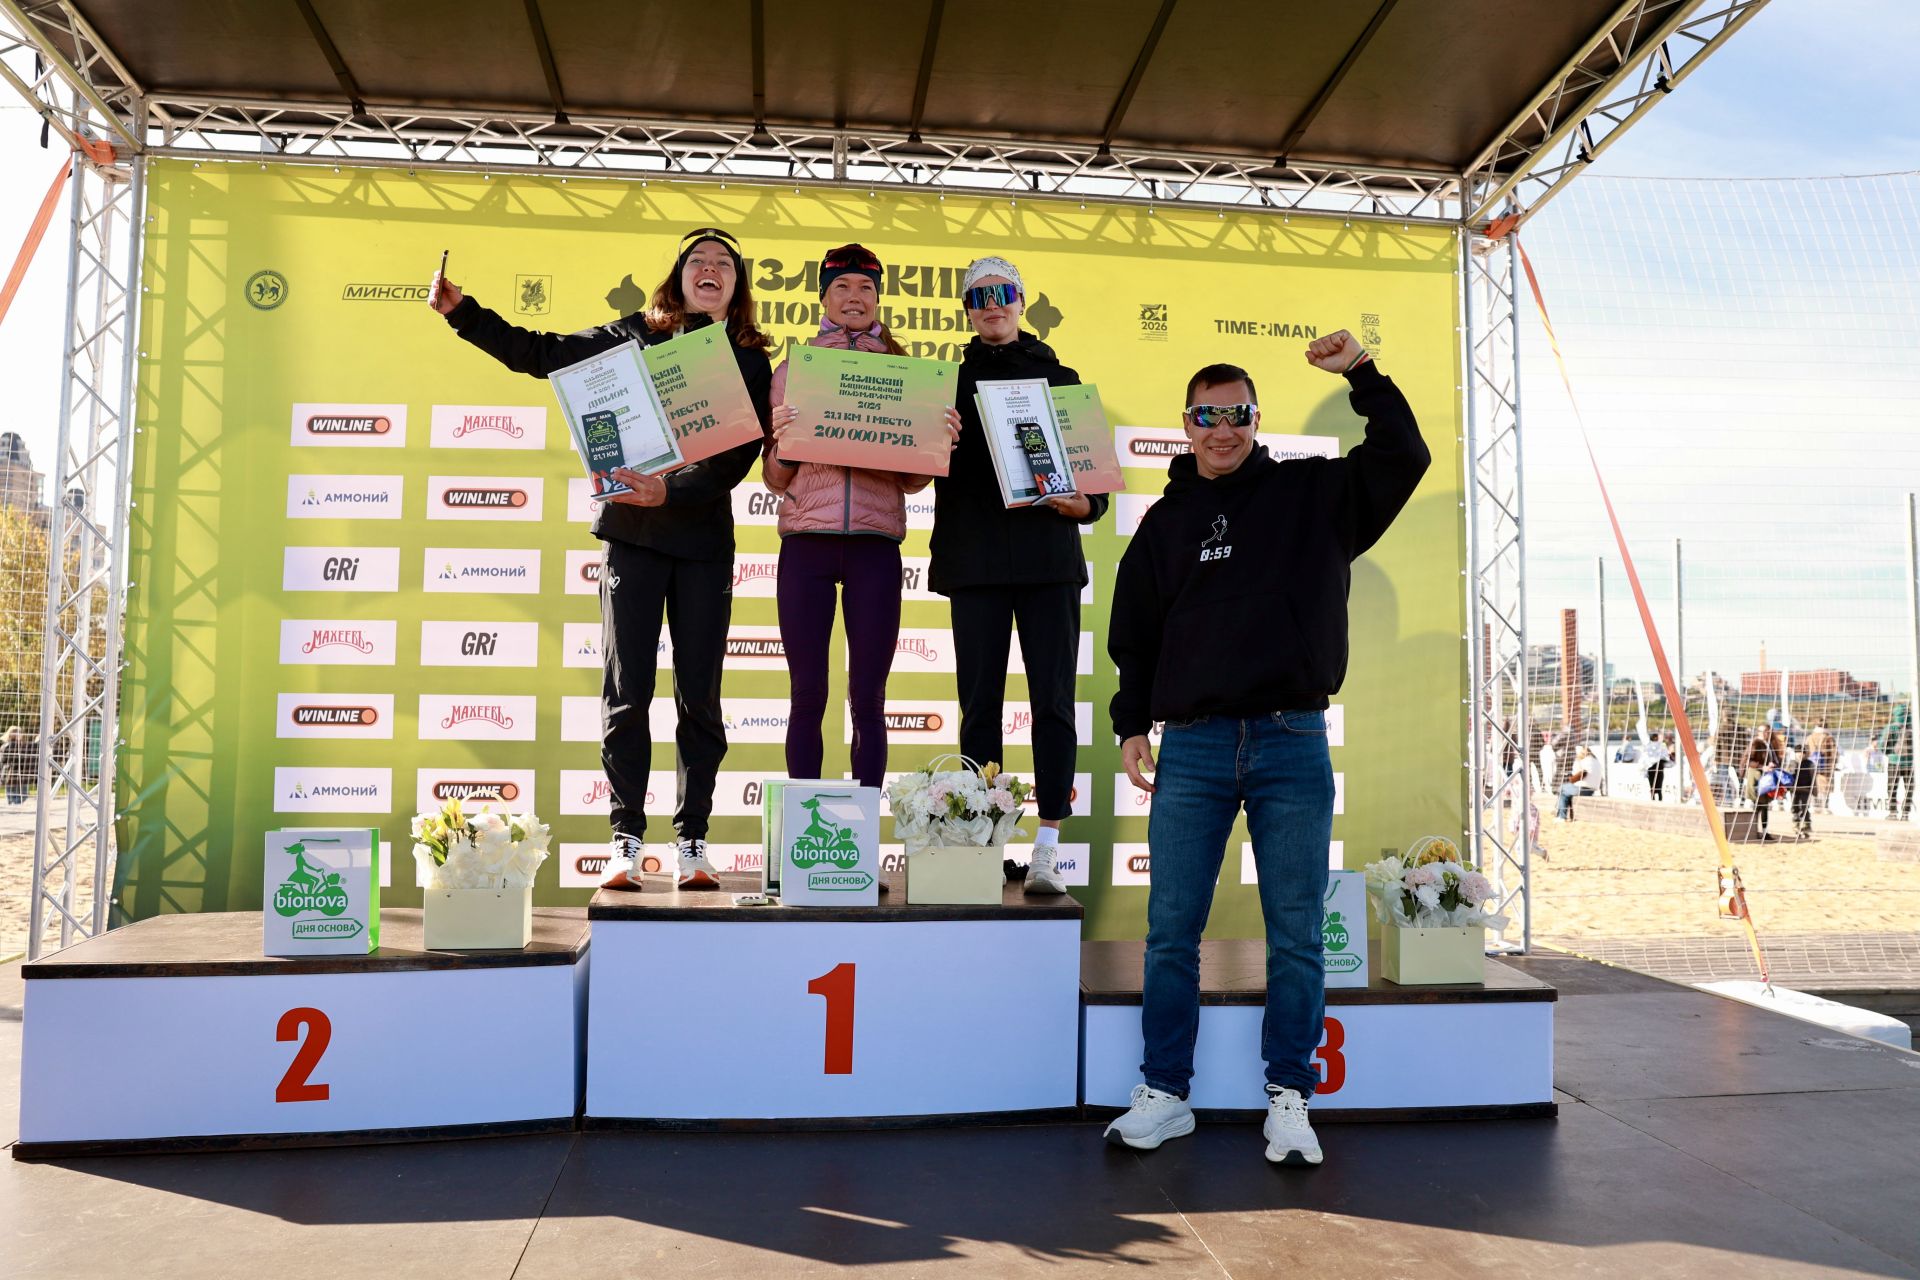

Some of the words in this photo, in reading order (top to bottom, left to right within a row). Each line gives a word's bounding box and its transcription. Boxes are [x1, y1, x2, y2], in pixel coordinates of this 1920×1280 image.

[346, 286, 431, 299] МИНСПО
[1141, 321, 1168, 331] 2026
[841, 373, 904, 387] КАЗАНСКИЙ
[588, 387, 629, 412] ДИПЛОМ
[857, 401, 881, 410] 2026
[670, 400, 709, 420] МЕСТО
[313, 419, 373, 432] WINLINE
[681, 414, 720, 438] РУБ.
[824, 411, 841, 420] 21,1
[844, 412, 861, 422] КМ
[872, 415, 911, 427] МЕСТО
[814, 425, 845, 439] 200
[848, 429, 877, 443] 000
[879, 431, 917, 447] РУБ.
[1134, 441, 1189, 455] WINLINE
[324, 491, 388, 503] АММОНИЙ
[449, 492, 510, 505] WINLINE
[1200, 545, 1232, 561] 0:59
[323, 557, 359, 581] GRi
[461, 565, 526, 578] АММОНИЙ
[733, 564, 777, 586] МАХЕЕ
[901, 567, 921, 590] Ri
[461, 632, 498, 656] GRi
[298, 709, 360, 722] WINLINE
[741, 717, 787, 727] АММОН
[886, 716, 925, 728] NLINE
[312, 784, 377, 796] АММОНИЙ
[438, 785, 500, 799] WINLINE
[793, 844, 859, 861] bionova
[882, 854, 904, 872] GR
[811, 877, 829, 885] ДНЯ
[831, 876, 867, 885] ОСНОВА
[275, 892, 347, 909] bionova
[296, 924, 316, 933] ДНЯ
[317, 923, 356, 933] ОСНОВА
[808, 963, 856, 1075] 1
[276, 1007, 332, 1103] 2
[1311, 1016, 1346, 1095] 3
